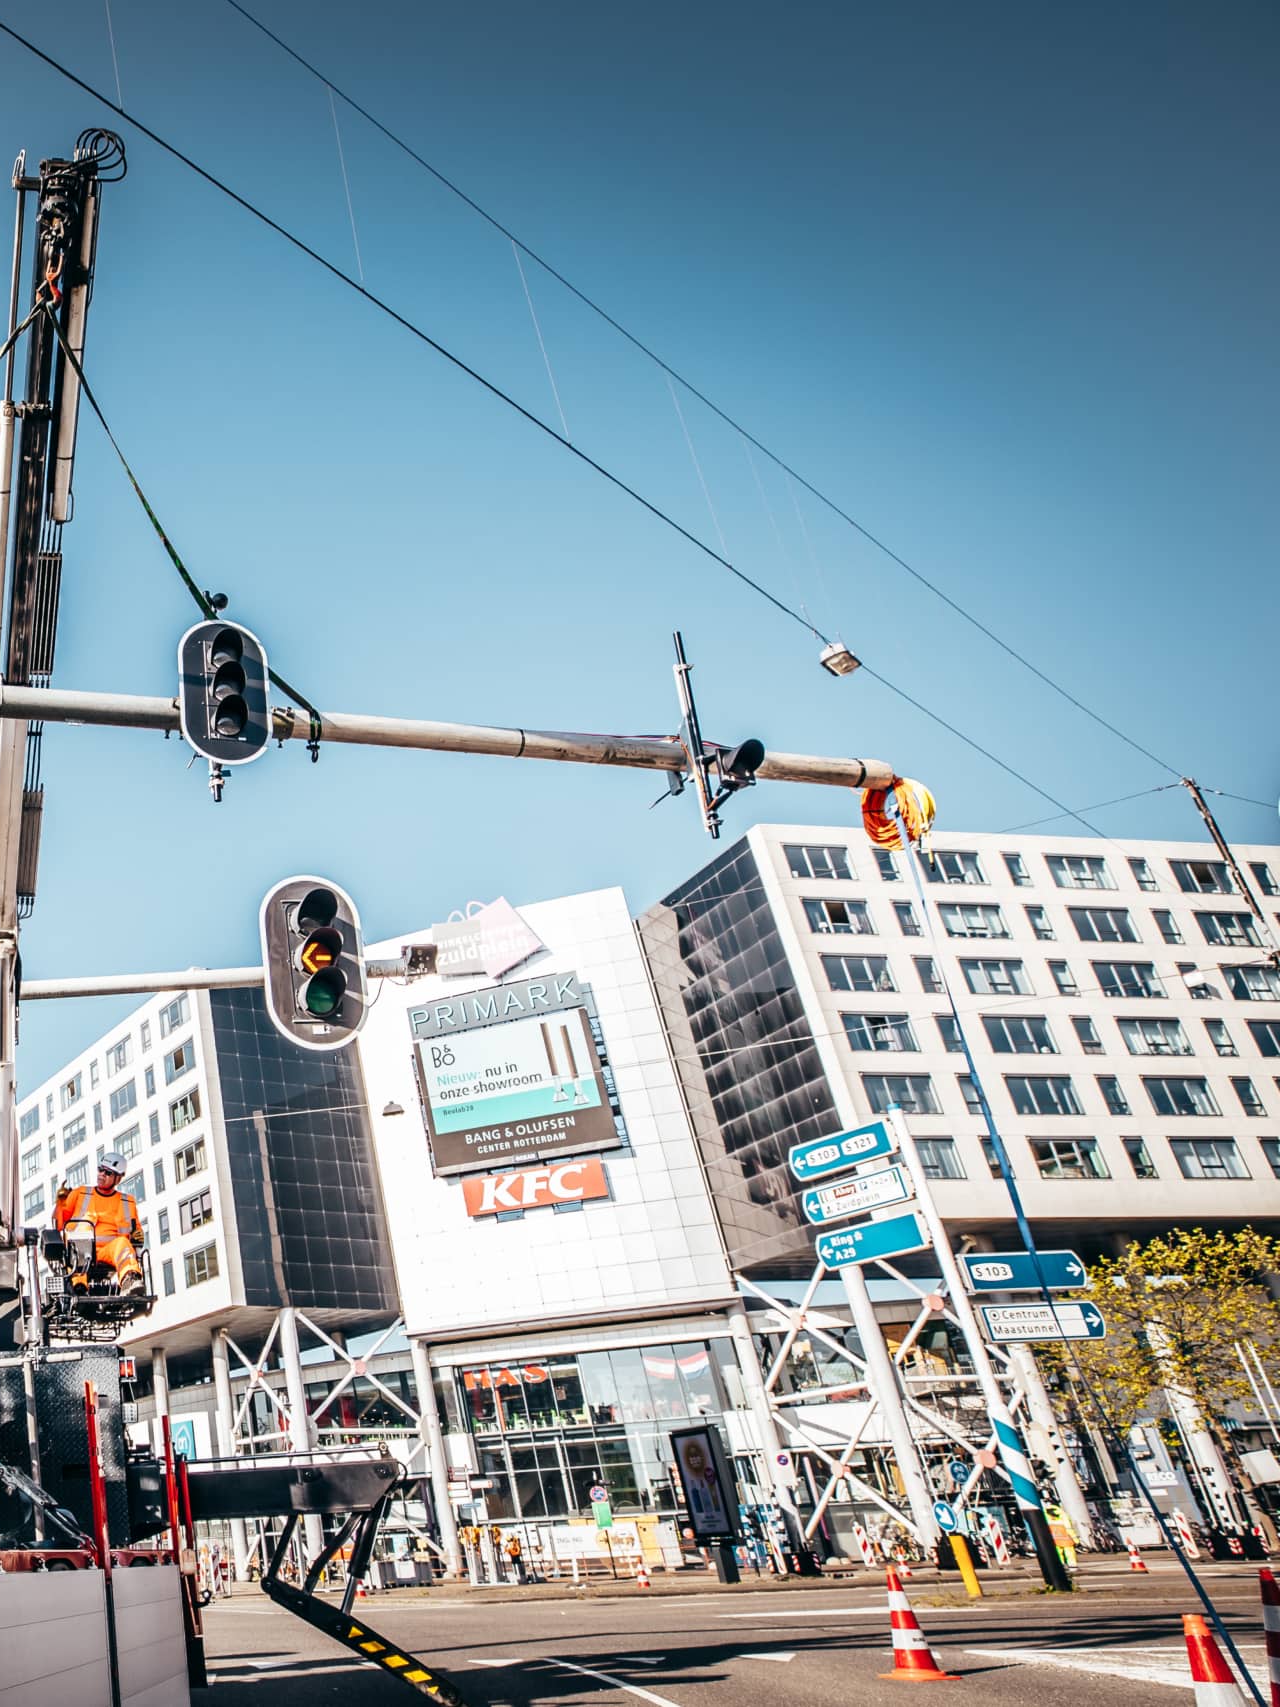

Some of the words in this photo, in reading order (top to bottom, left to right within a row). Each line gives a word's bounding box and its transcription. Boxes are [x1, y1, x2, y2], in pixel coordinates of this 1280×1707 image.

[410, 976, 580, 1034] PRIMARK
[437, 1071, 481, 1086] Nieuw:
[485, 1066, 501, 1078] nu
[505, 1062, 518, 1073] in
[440, 1086, 470, 1100] onze
[473, 1073, 543, 1094] showroom
[465, 1128, 501, 1145] BANG
[504, 1127, 514, 1138] &
[515, 1115, 576, 1136] OLUFSEN
[477, 1142, 511, 1154] CENTER
[513, 1132, 567, 1148] ROTTERDAM
[479, 1162, 585, 1211] KFC
[837, 1192, 880, 1211] Zuidplein
[830, 1235, 854, 1248] Ring
[835, 1247, 857, 1260] A29
[1001, 1310, 1049, 1320] Centrum
[993, 1323, 1060, 1335] Maastunnel
